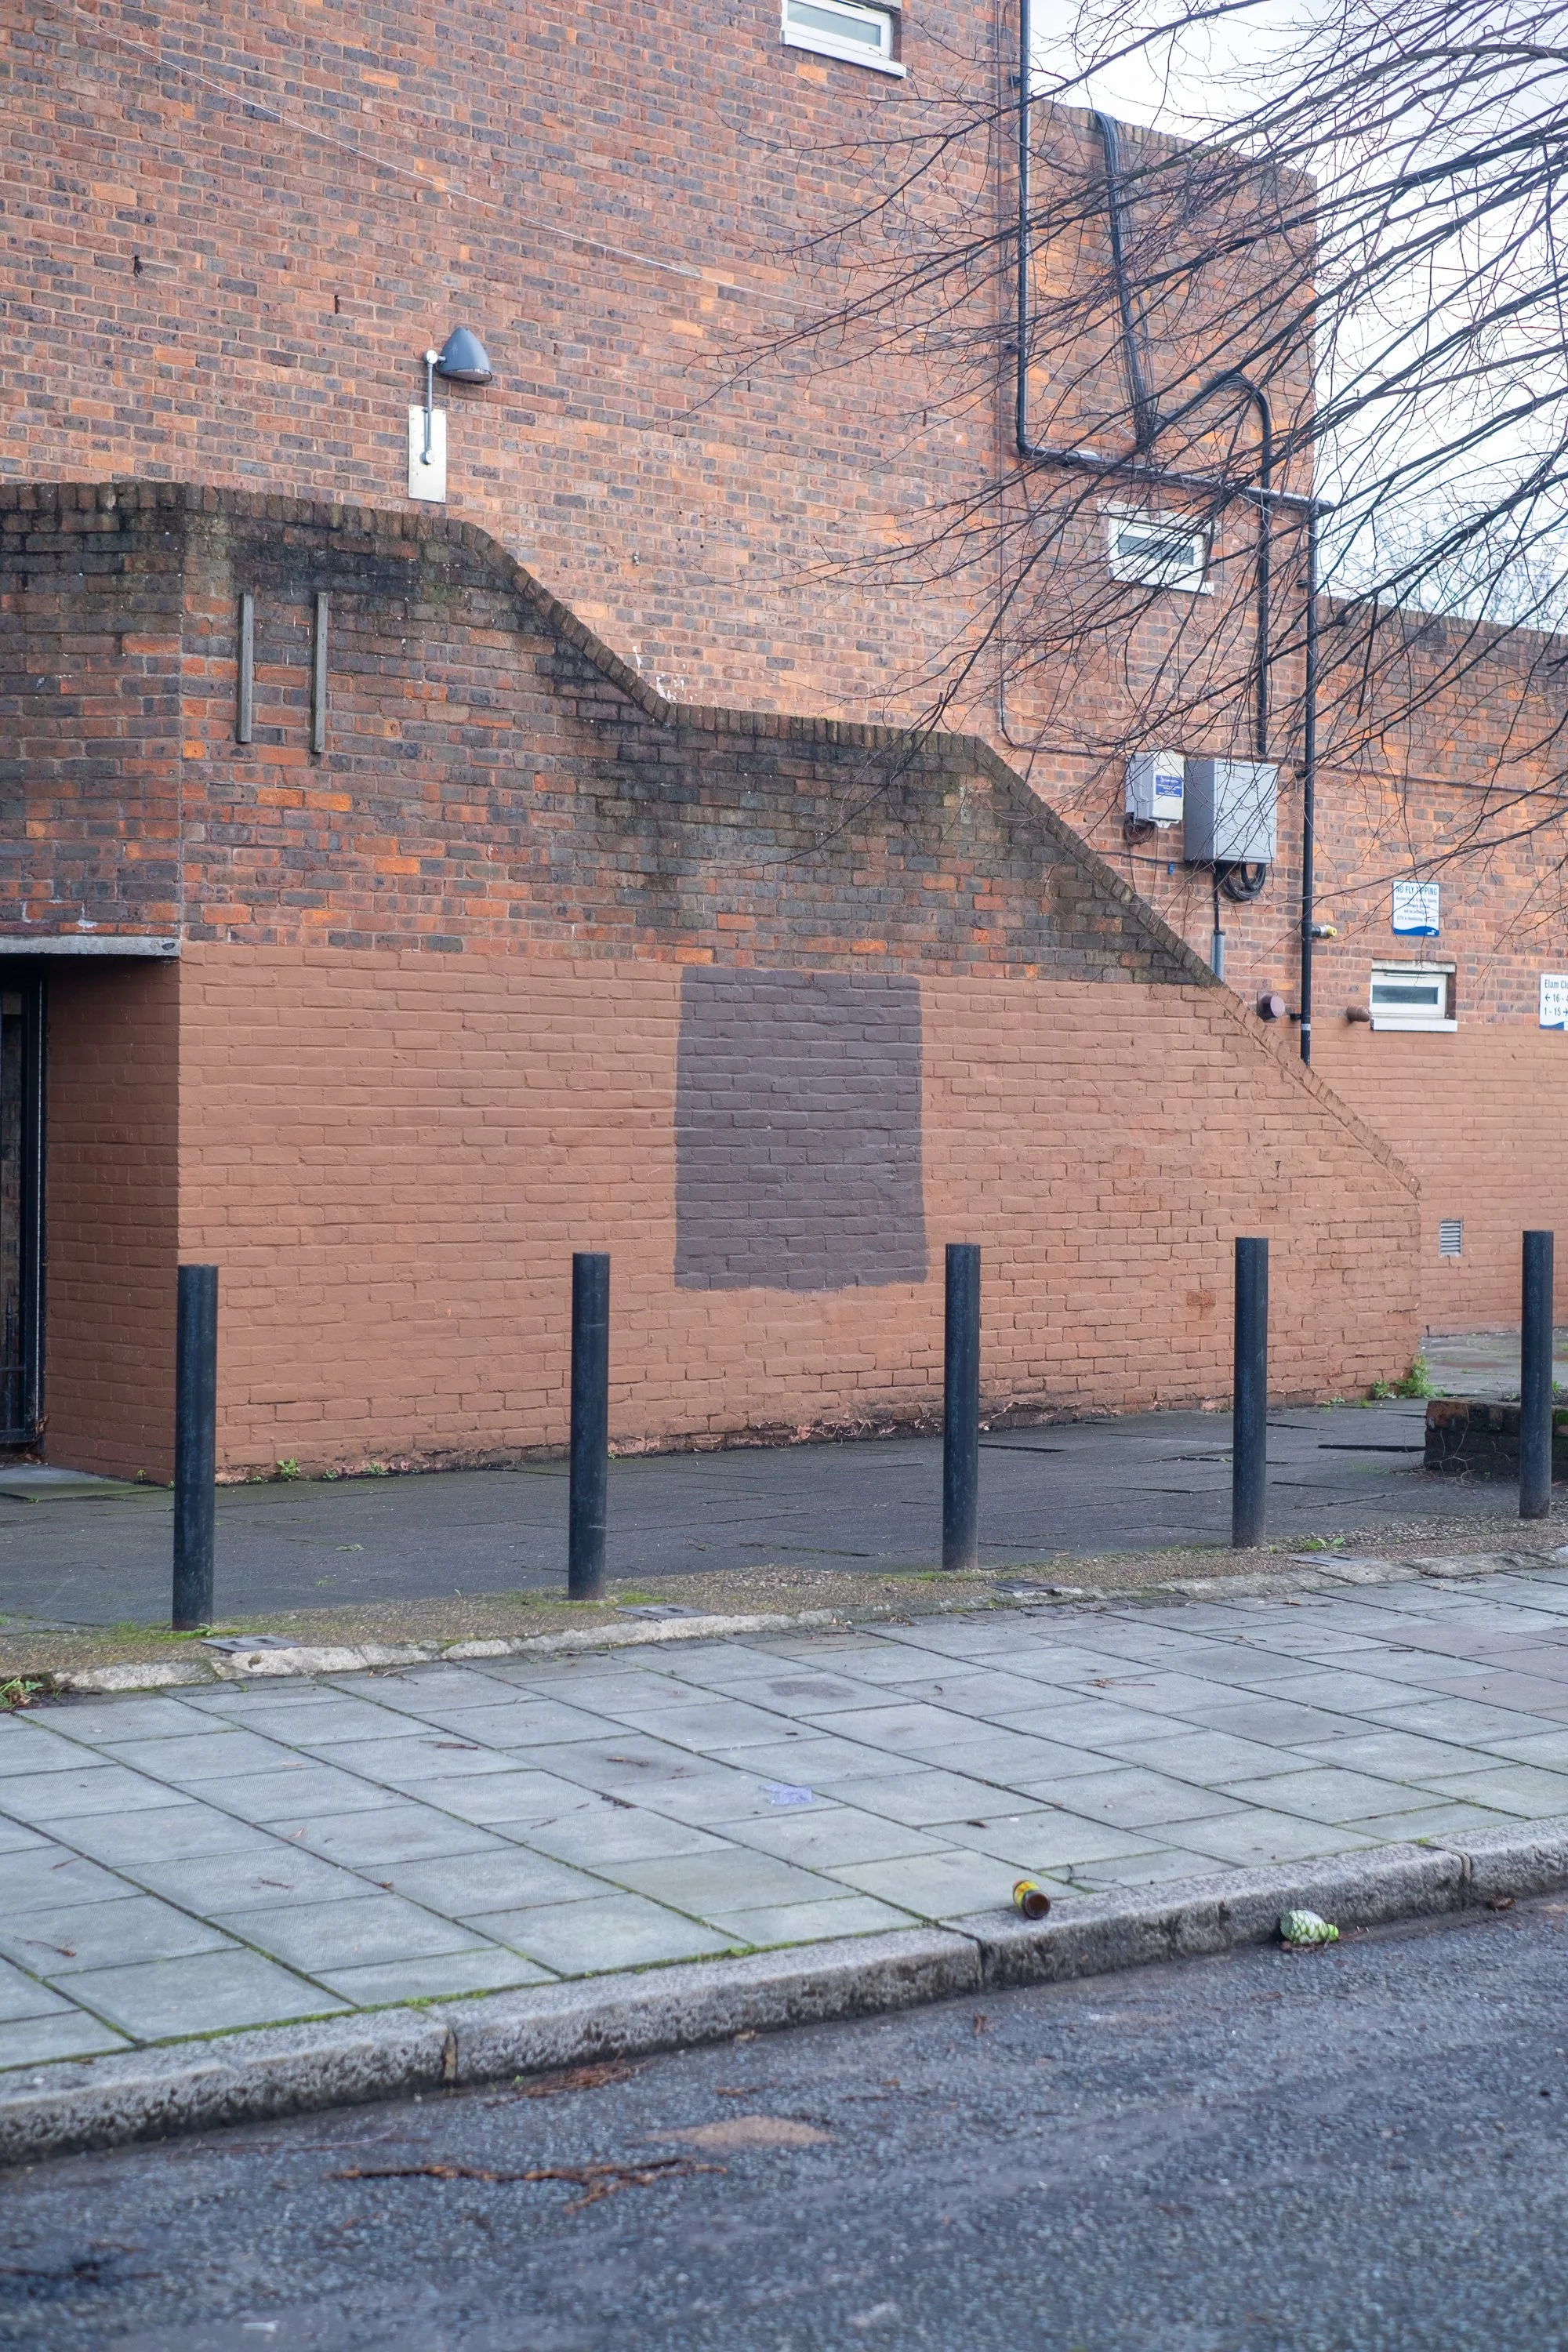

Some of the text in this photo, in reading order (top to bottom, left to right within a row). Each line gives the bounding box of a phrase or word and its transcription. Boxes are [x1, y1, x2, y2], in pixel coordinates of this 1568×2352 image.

[1416, 887, 1437, 895] TPPING
[1544, 979, 1559, 989] Elam
[1553, 993, 1559, 1003] 16
[1555, 1007, 1561, 1017] 15
